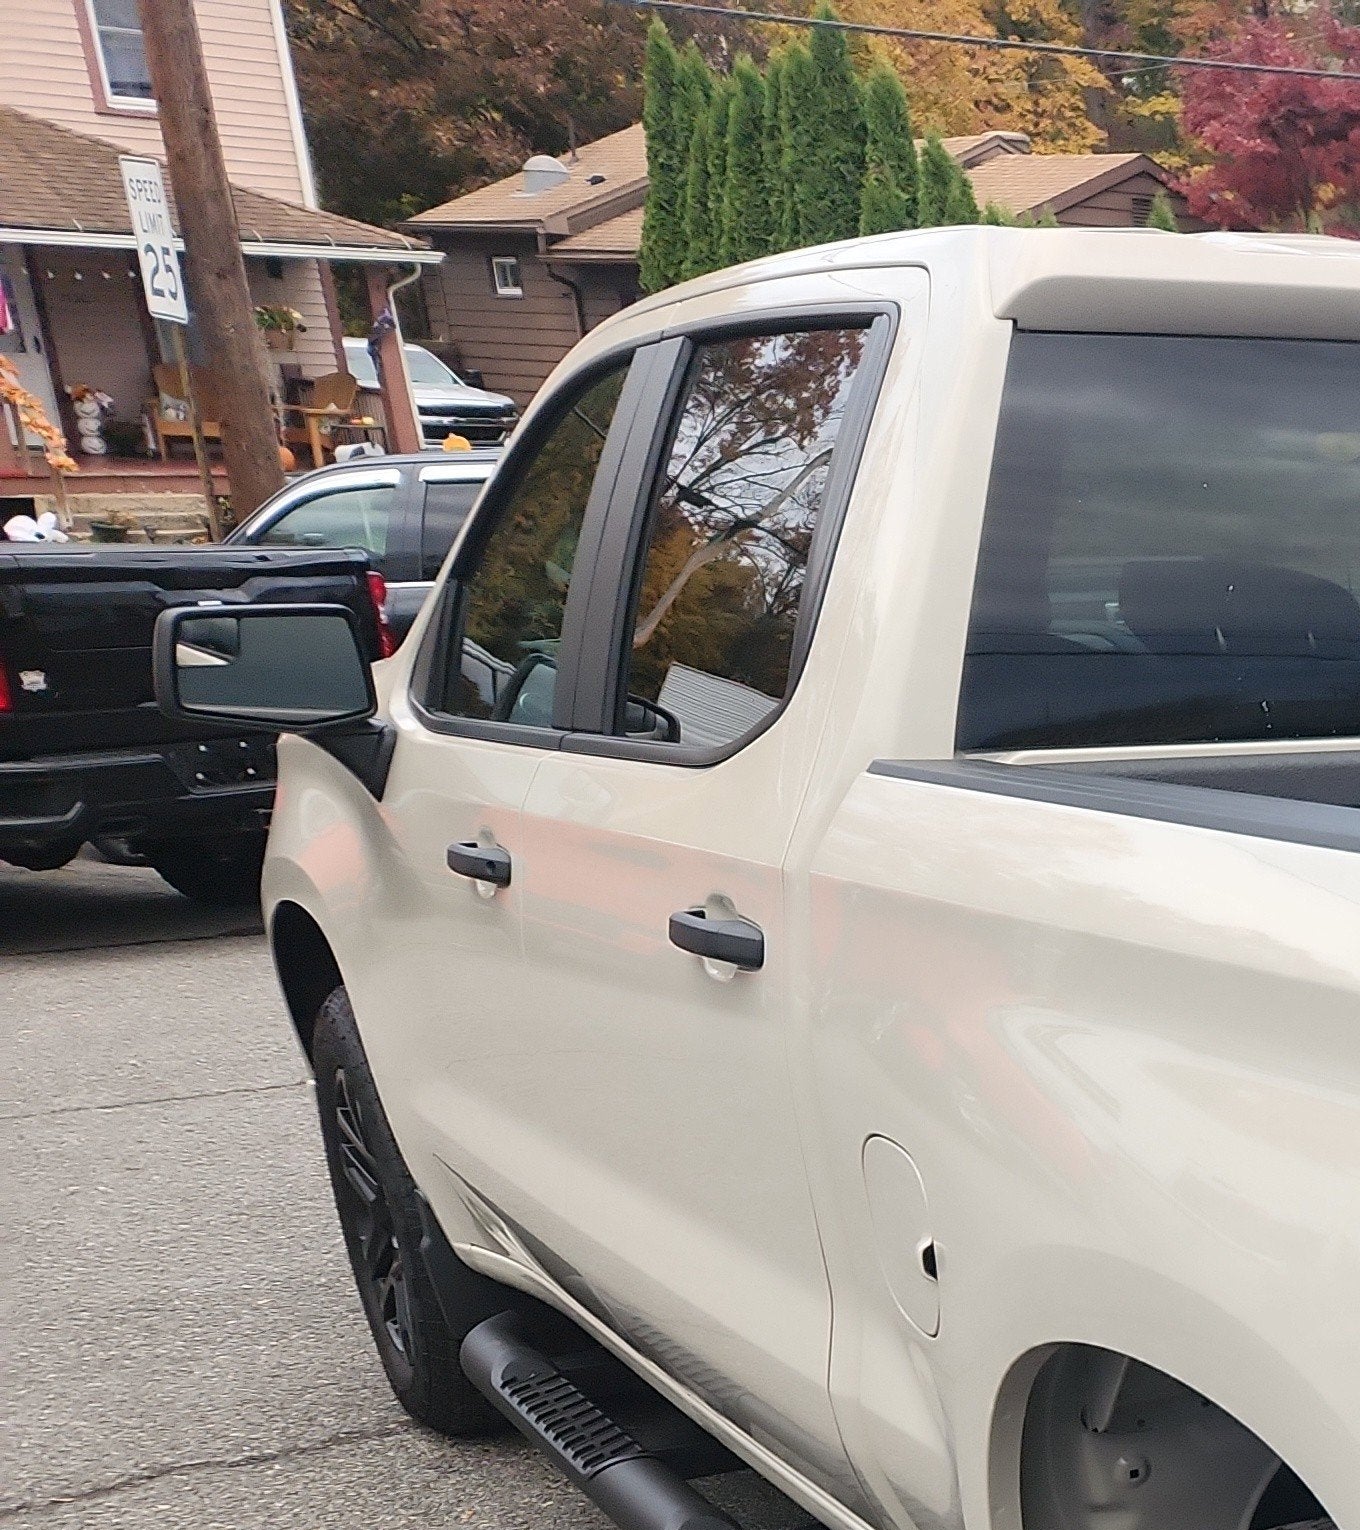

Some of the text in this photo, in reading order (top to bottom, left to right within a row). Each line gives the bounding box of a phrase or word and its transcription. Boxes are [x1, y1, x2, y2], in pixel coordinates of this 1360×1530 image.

[128, 177, 162, 203] SPEED
[138, 210, 165, 237] LIMIT
[143, 242, 178, 301] 25
